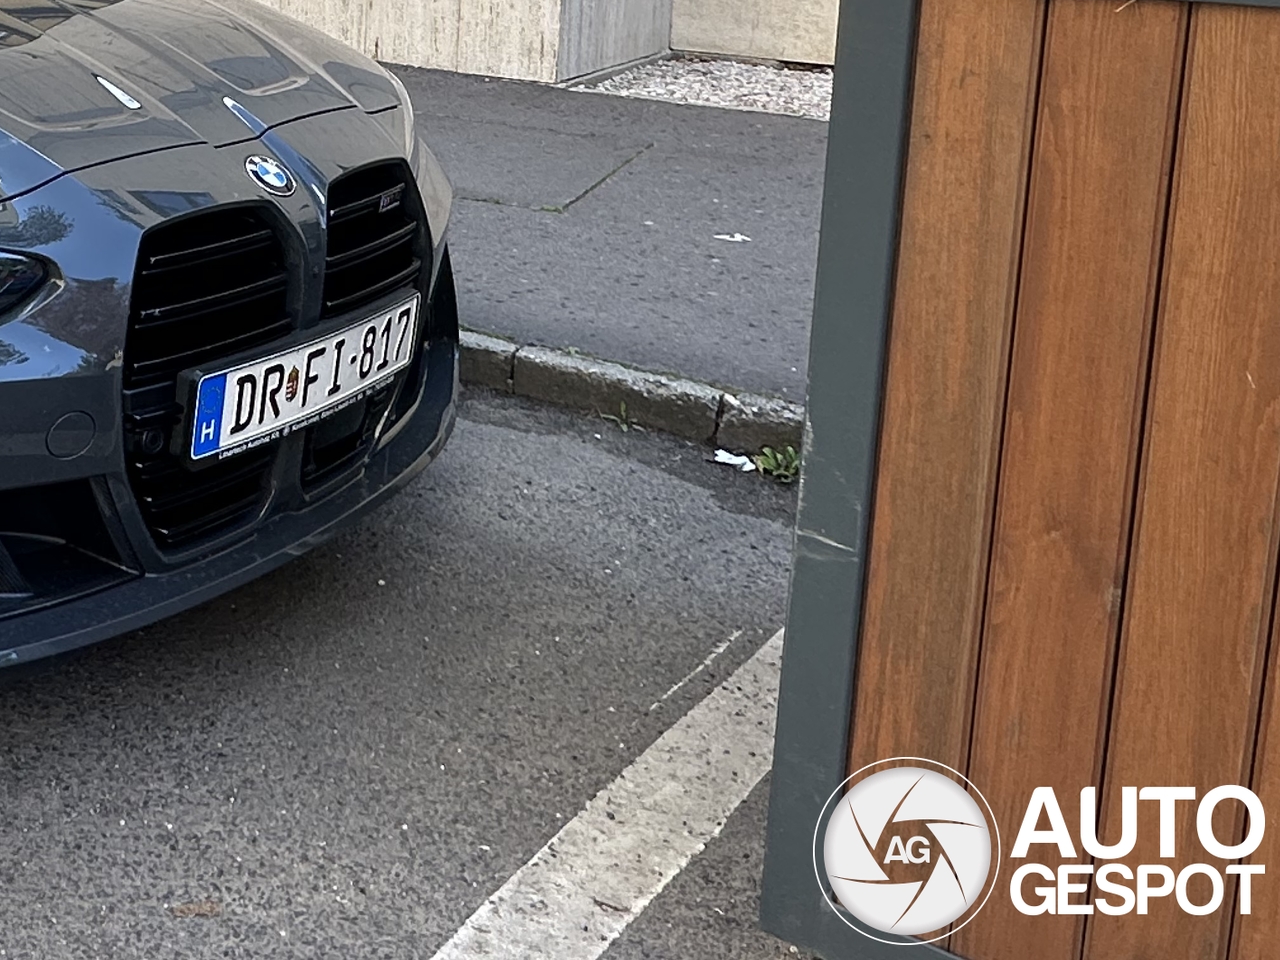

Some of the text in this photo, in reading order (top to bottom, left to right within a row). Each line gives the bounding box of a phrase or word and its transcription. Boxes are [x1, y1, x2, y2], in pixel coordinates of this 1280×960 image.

[230, 363, 284, 435] DR
[301, 307, 411, 408] FI-817
[200, 419, 215, 444] H
